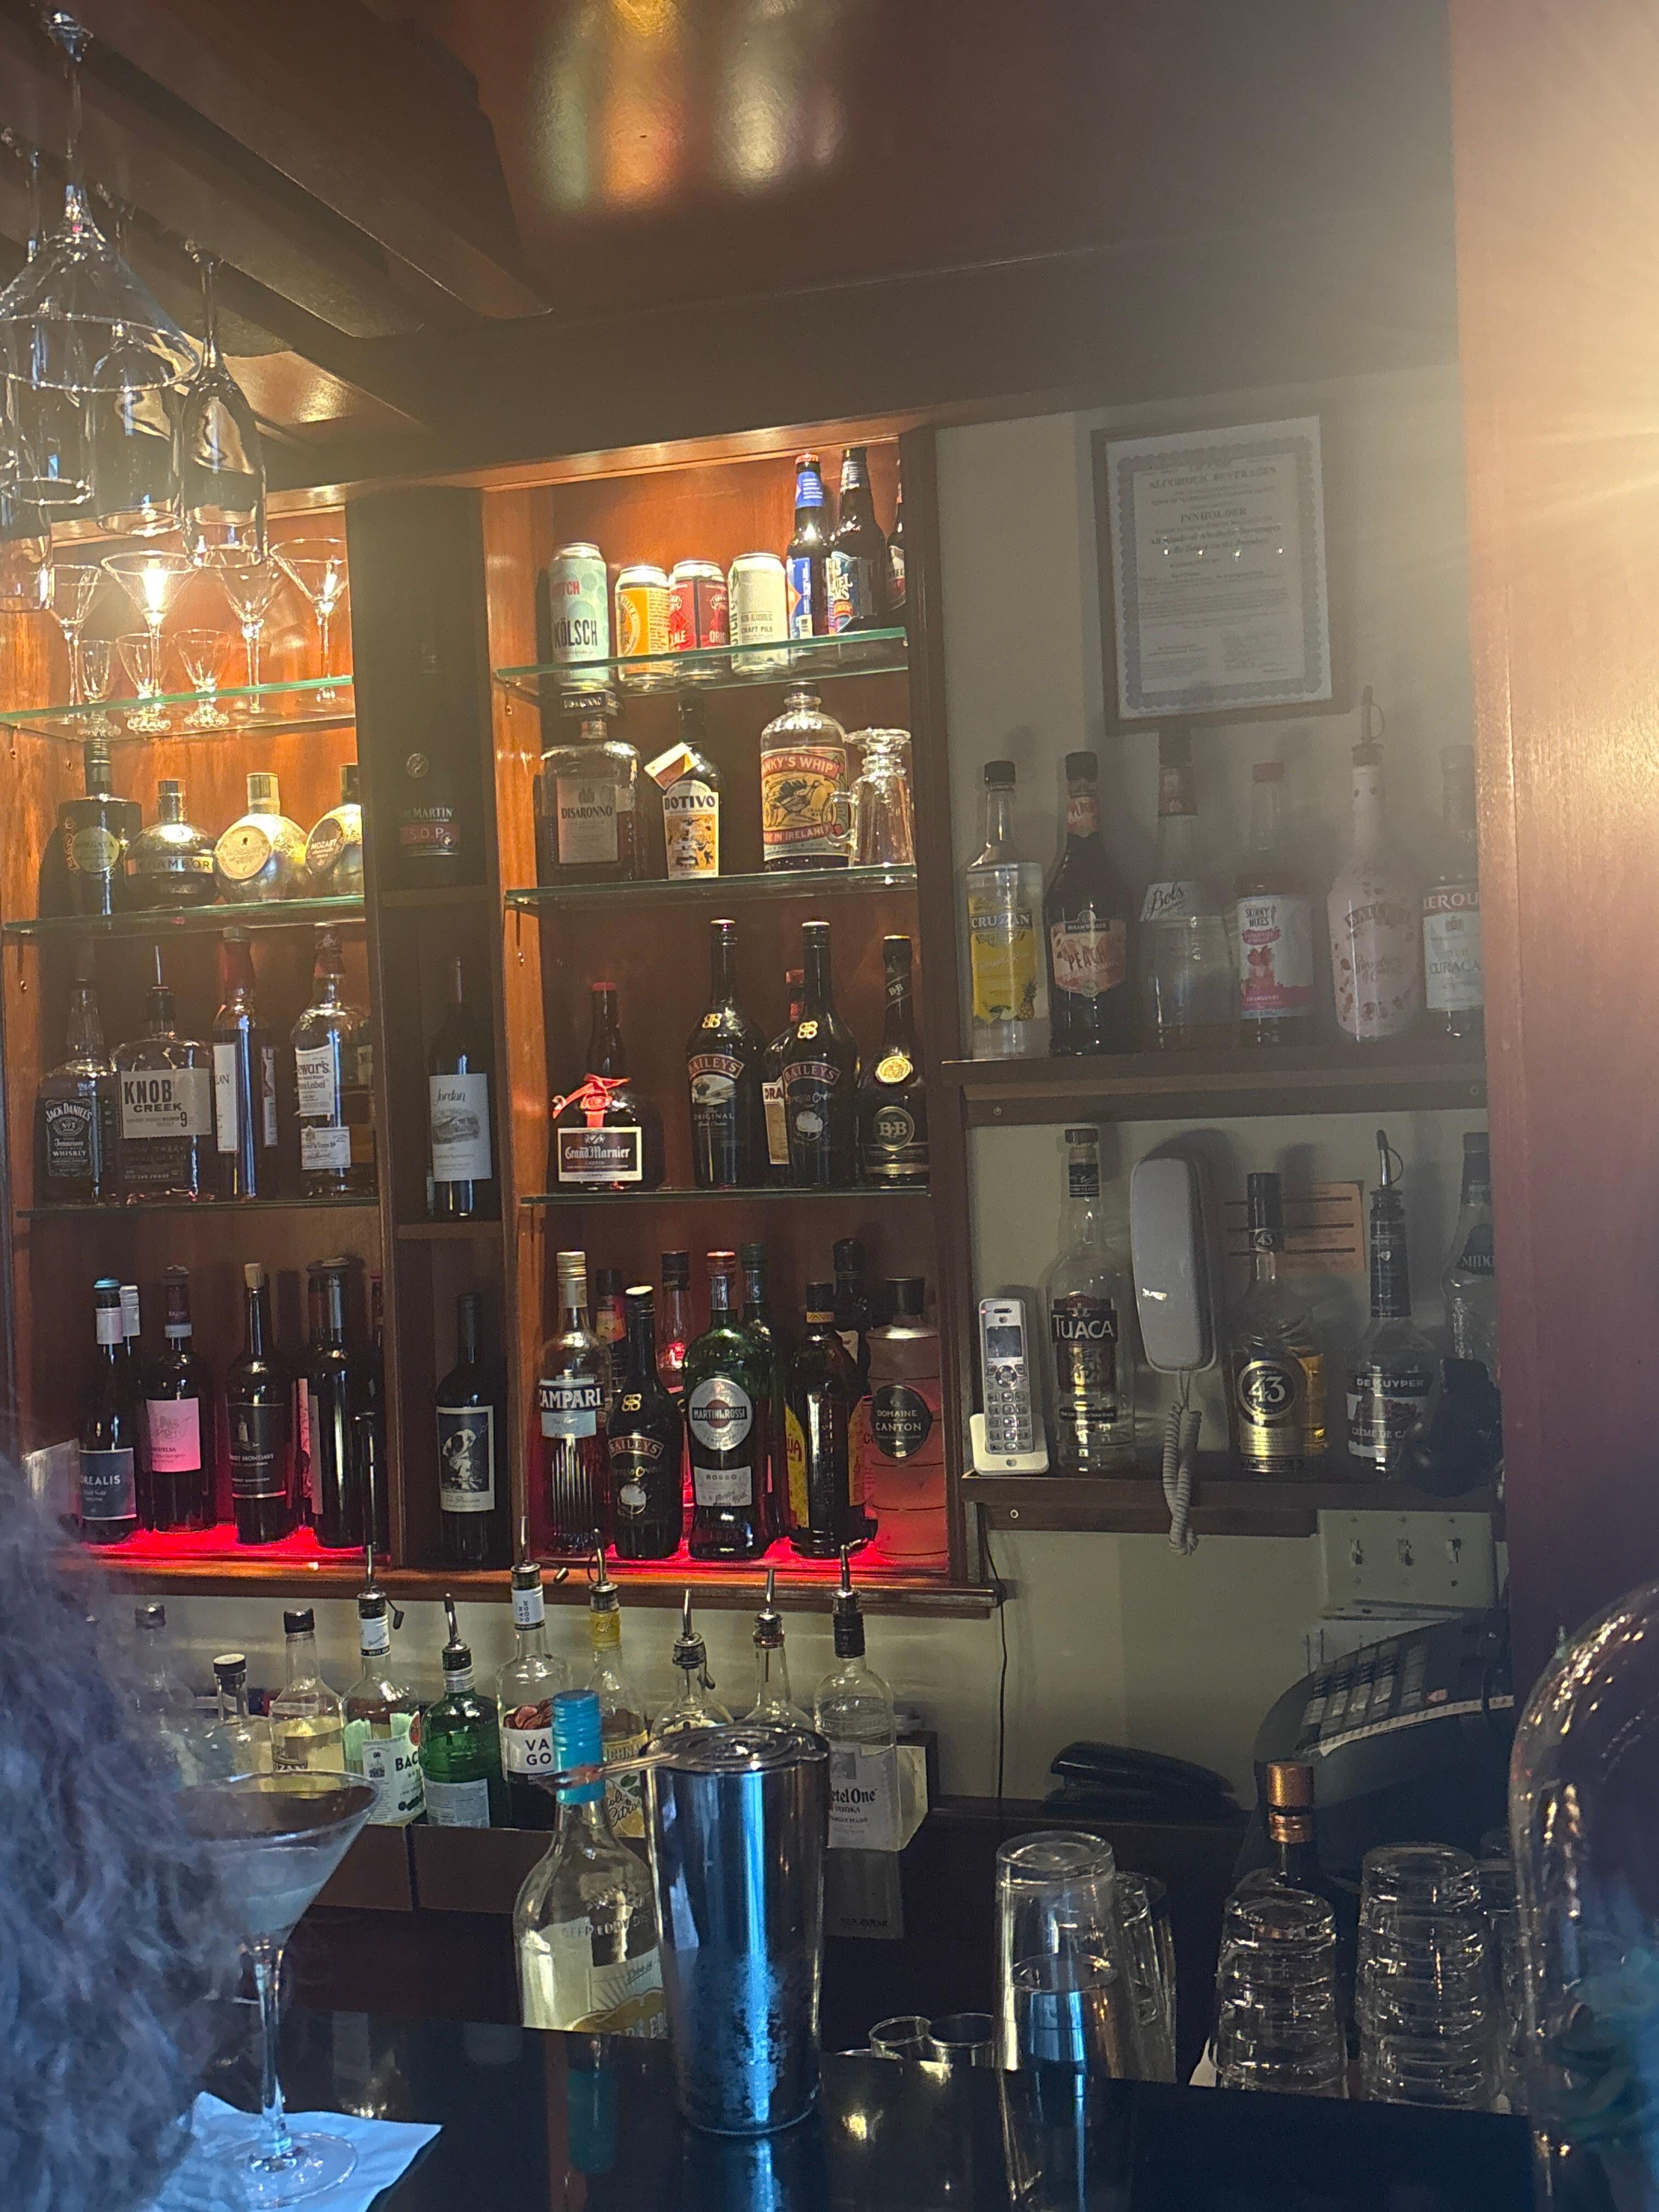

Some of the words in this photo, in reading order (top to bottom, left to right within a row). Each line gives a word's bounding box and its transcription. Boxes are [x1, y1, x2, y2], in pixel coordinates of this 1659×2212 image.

[552, 617, 597, 648] KÖLSCH
[799, 757, 833, 774] WHIP
[664, 795, 715, 810] BOTIVO
[413, 807, 453, 818] MARTIN
[561, 806, 613, 820] DISARONNO
[1145, 883, 1184, 921] Bols
[1245, 906, 1269, 918] SKINNY
[971, 911, 1033, 930] CRUZAN
[1249, 916, 1269, 927] MIXES
[1067, 945, 1107, 972] PEACH
[785, 1065, 835, 1081] BAILEYS
[124, 1079, 172, 1104] KNOB
[46, 1105, 62, 1122] JACK
[63, 1102, 93, 1122] DANIEL'S
[133, 1103, 182, 1113] CREEK
[693, 1111, 735, 1120] ORIGINAL
[180, 1111, 188, 1127] 9
[1256, 1233, 1273, 1246] 43
[1052, 1314, 1114, 1339] TUACA
[1248, 1376, 1286, 1403] 43
[539, 1387, 603, 1409] AMPARI
[877, 1409, 918, 1418] DOMAINE
[875, 1422, 922, 1431] CANTON
[608, 1438, 659, 1454] BAILEYS
[525, 1738, 550, 1752] VA
[526, 1752, 552, 1766] GO
[831, 1788, 850, 1804] etel
[851, 1788, 876, 1804] One
[833, 1805, 861, 1814] VODKA
